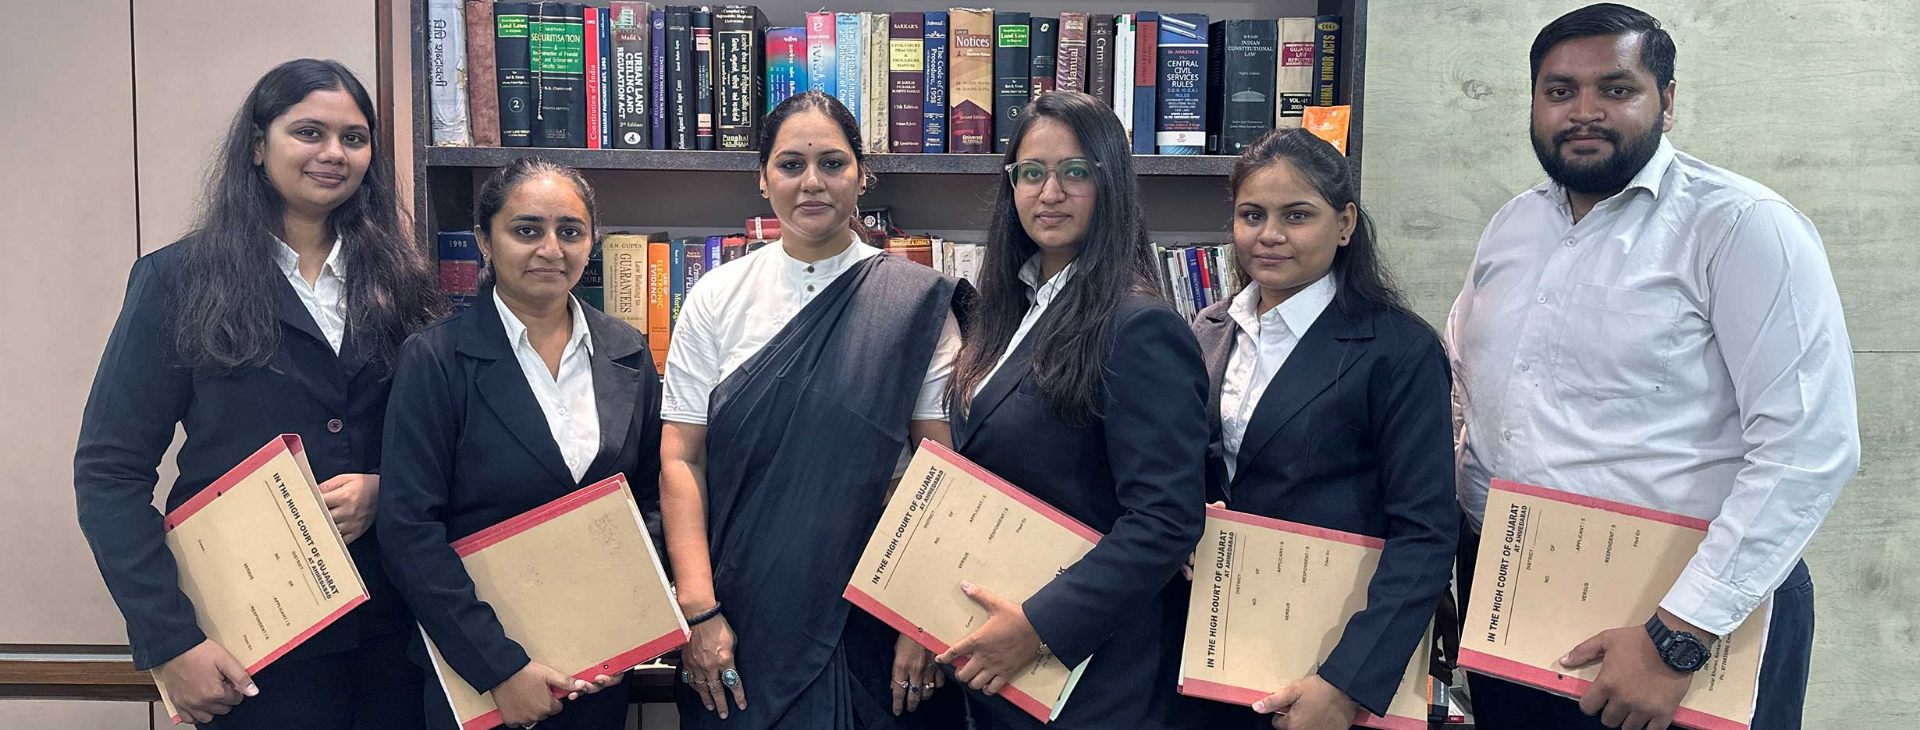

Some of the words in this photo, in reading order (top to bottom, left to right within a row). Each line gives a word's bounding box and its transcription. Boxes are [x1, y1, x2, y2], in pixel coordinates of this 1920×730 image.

[956, 36, 990, 47] Notices
[1322, 35, 1335, 54] ACTS
[626, 53, 634, 93] CEILING
[634, 52, 643, 85] URBAN
[1067, 48, 1078, 86] Manual
[1321, 56, 1334, 80] MINOR
[937, 80, 943, 89] of
[513, 100, 520, 108] 2
[635, 88, 643, 114] LAND
[620, 254, 631, 313] GUARANTEES
[634, 274, 642, 298] Relating
[920, 502, 925, 511] AT
[924, 470, 944, 503] AHMEDABAD
[272, 472, 282, 484] IN
[278, 483, 290, 499] THE
[286, 499, 300, 520] HIGH
[297, 520, 314, 546] COURT
[311, 547, 320, 558] OF
[317, 560, 339, 595] GUJARAT
[872, 574, 880, 584] IN
[876, 558, 889, 575] THE
[885, 539, 899, 559] HIGH
[896, 512, 913, 538] COURT
[910, 500, 918, 511] OF
[916, 466, 938, 500] GUJARAT
[1506, 503, 1520, 542] GUJARAT
[1516, 505, 1528, 543] AHMEDABAD
[1217, 530, 1227, 569] GUJARAT
[1503, 543, 1512, 557] OF
[1514, 544, 1521, 554] AT
[308, 557, 314, 565] AT
[312, 565, 331, 600] AHMEDABAD
[1215, 569, 1223, 583] OF
[1224, 569, 1230, 578] AT
[1497, 558, 1510, 589] COURT
[1211, 584, 1221, 614] COURT
[1492, 589, 1504, 613] HIGH
[1209, 615, 1218, 638] HIGH
[1489, 613, 1499, 631] THE
[1208, 639, 1216, 657] THE
[1487, 631, 1496, 643] IN
[1207, 658, 1215, 668] IN
